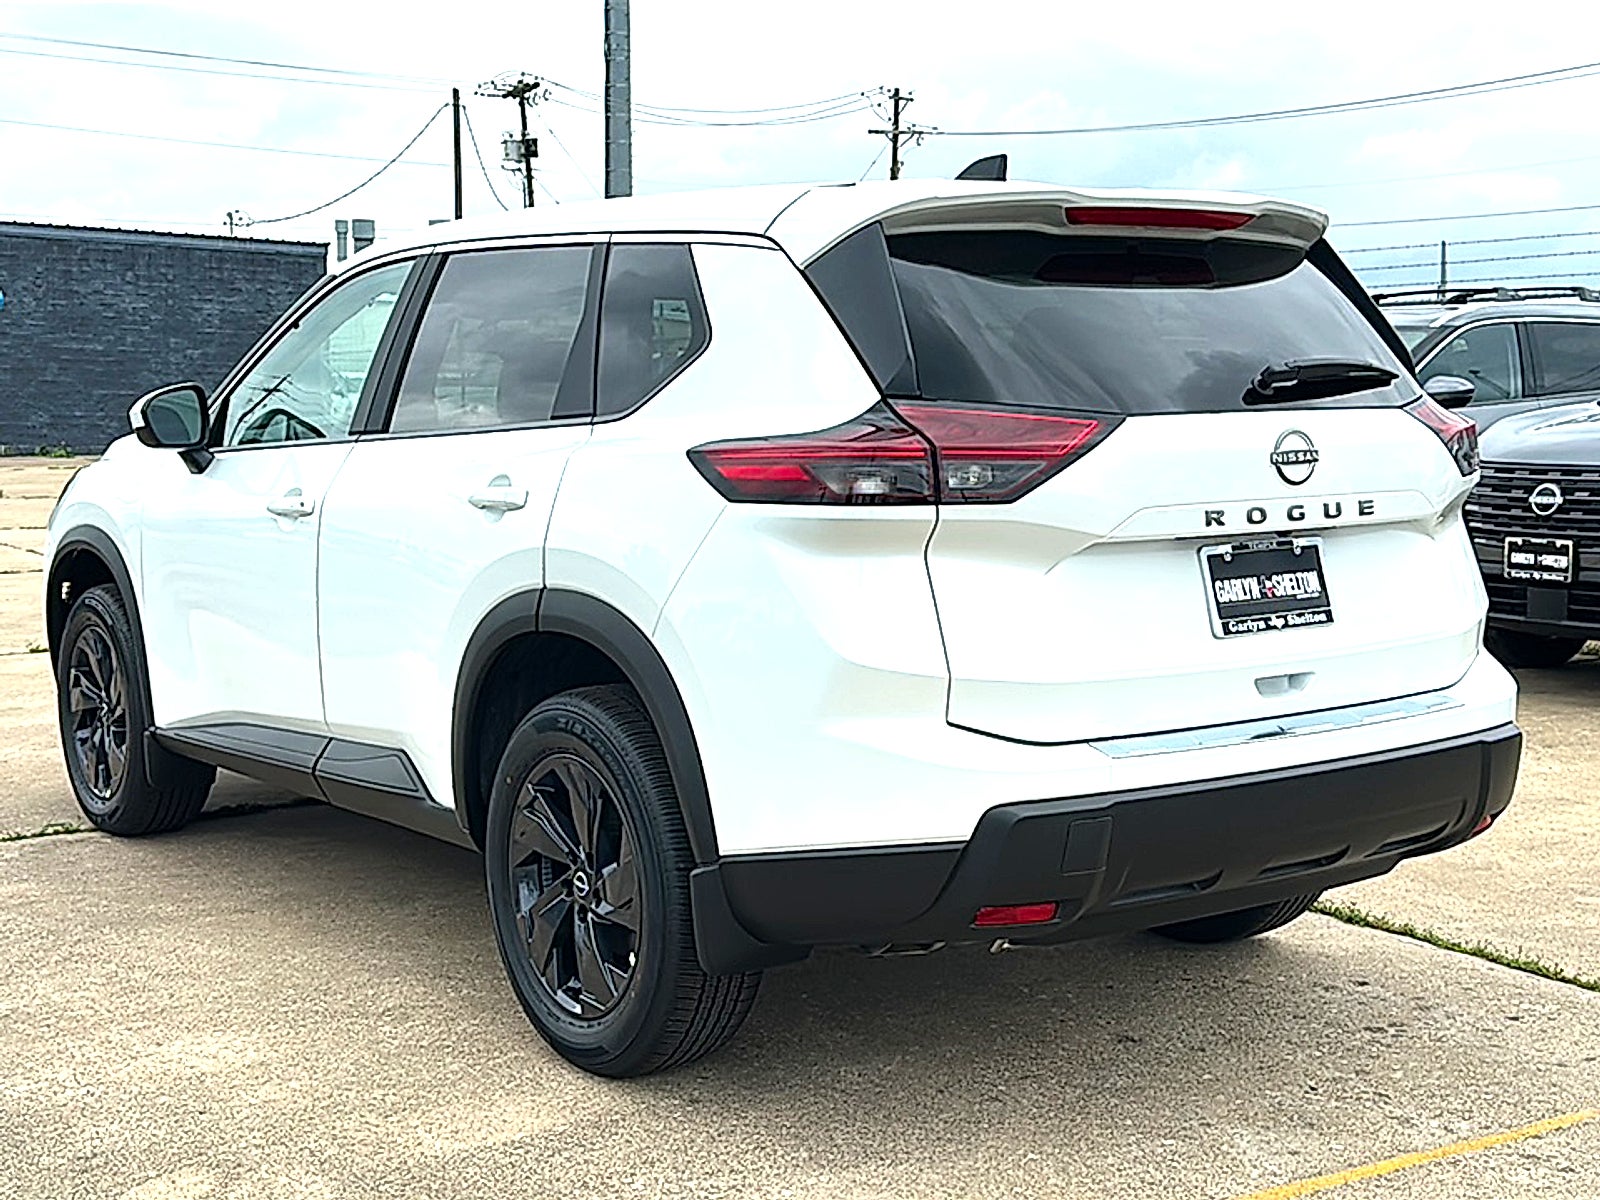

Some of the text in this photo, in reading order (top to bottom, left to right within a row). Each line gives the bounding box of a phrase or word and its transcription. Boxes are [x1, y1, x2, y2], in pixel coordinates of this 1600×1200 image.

[1271, 451, 1319, 463] NISSAN
[1205, 500, 1375, 527] ROGUE
[1214, 570, 1322, 603] GARLYN SHELTON
